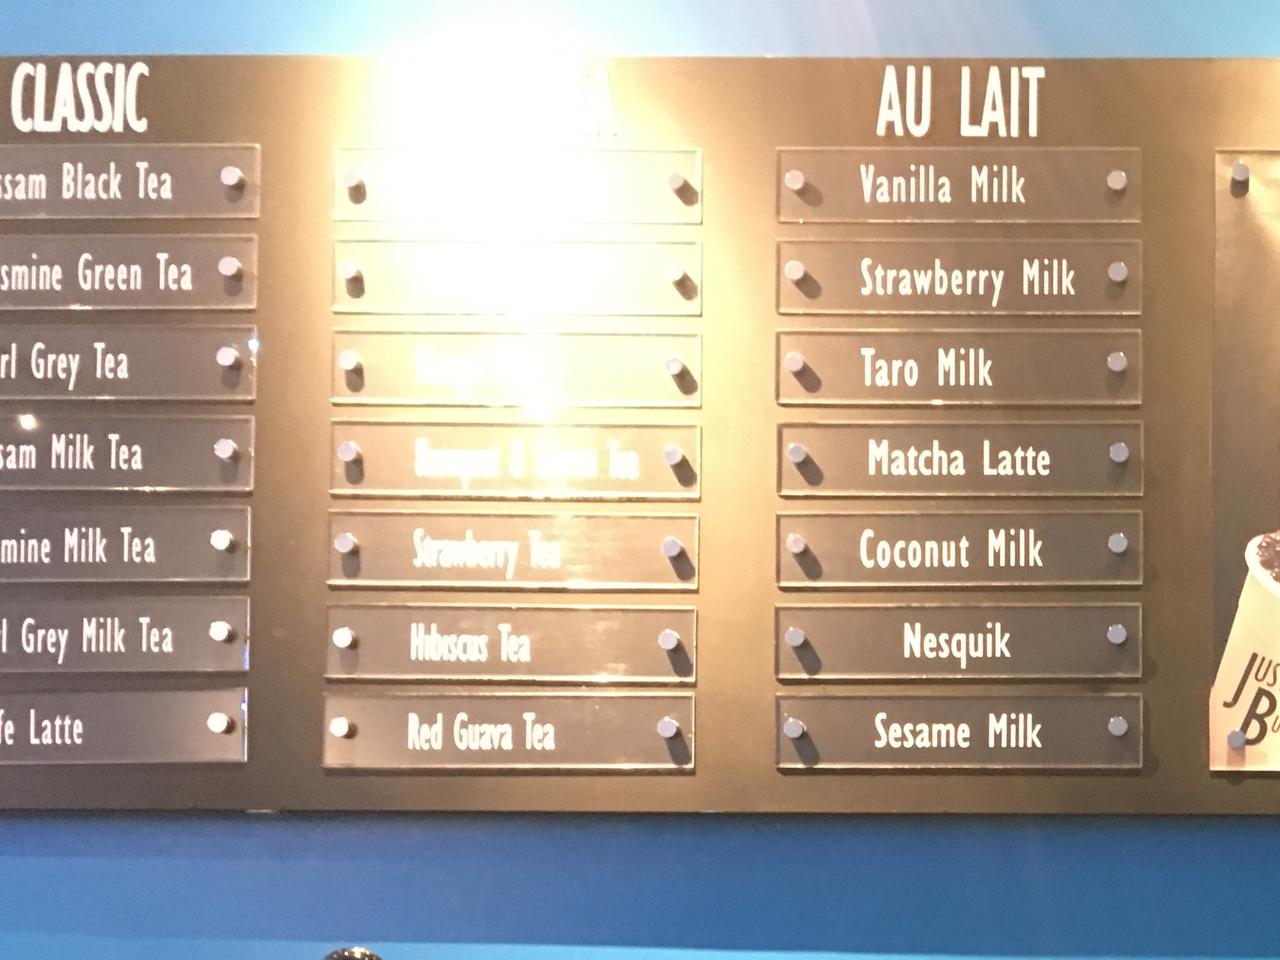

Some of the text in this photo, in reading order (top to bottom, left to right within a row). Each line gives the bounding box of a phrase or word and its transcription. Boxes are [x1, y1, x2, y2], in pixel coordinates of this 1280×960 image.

[11, 62, 149, 132] CLASSIC
[877, 65, 1045, 137] AU LAIT
[0, 162, 172, 200] sam Black Tea
[860, 165, 1025, 203] Vanilla Milk
[78, 253, 141, 290] Green
[157, 253, 192, 290] Tea
[861, 258, 1075, 307] Strawberry Milk
[31, 342, 79, 390] Grey
[94, 343, 128, 378] Tea
[861, 348, 992, 386] Taro Milk
[52, 434, 94, 469] Milk
[108, 434, 142, 470] Tea
[869, 439, 1050, 475] Matcha Latte
[65, 528, 106, 562] Milk
[121, 527, 155, 562] Tea
[413, 528, 563, 581] Strawberry Tea
[860, 529, 1042, 568] Coconut Milk
[22, 618, 68, 664] Grey
[83, 617, 125, 652] Milk
[139, 617, 173, 652] Tea
[411, 623, 531, 662] Hibiscus Tea
[904, 622, 1010, 669] Nesquik
[30, 709, 82, 744] Latte
[408, 712, 555, 750] Red Guava Tea
[875, 712, 1041, 748] Sesame Milk
